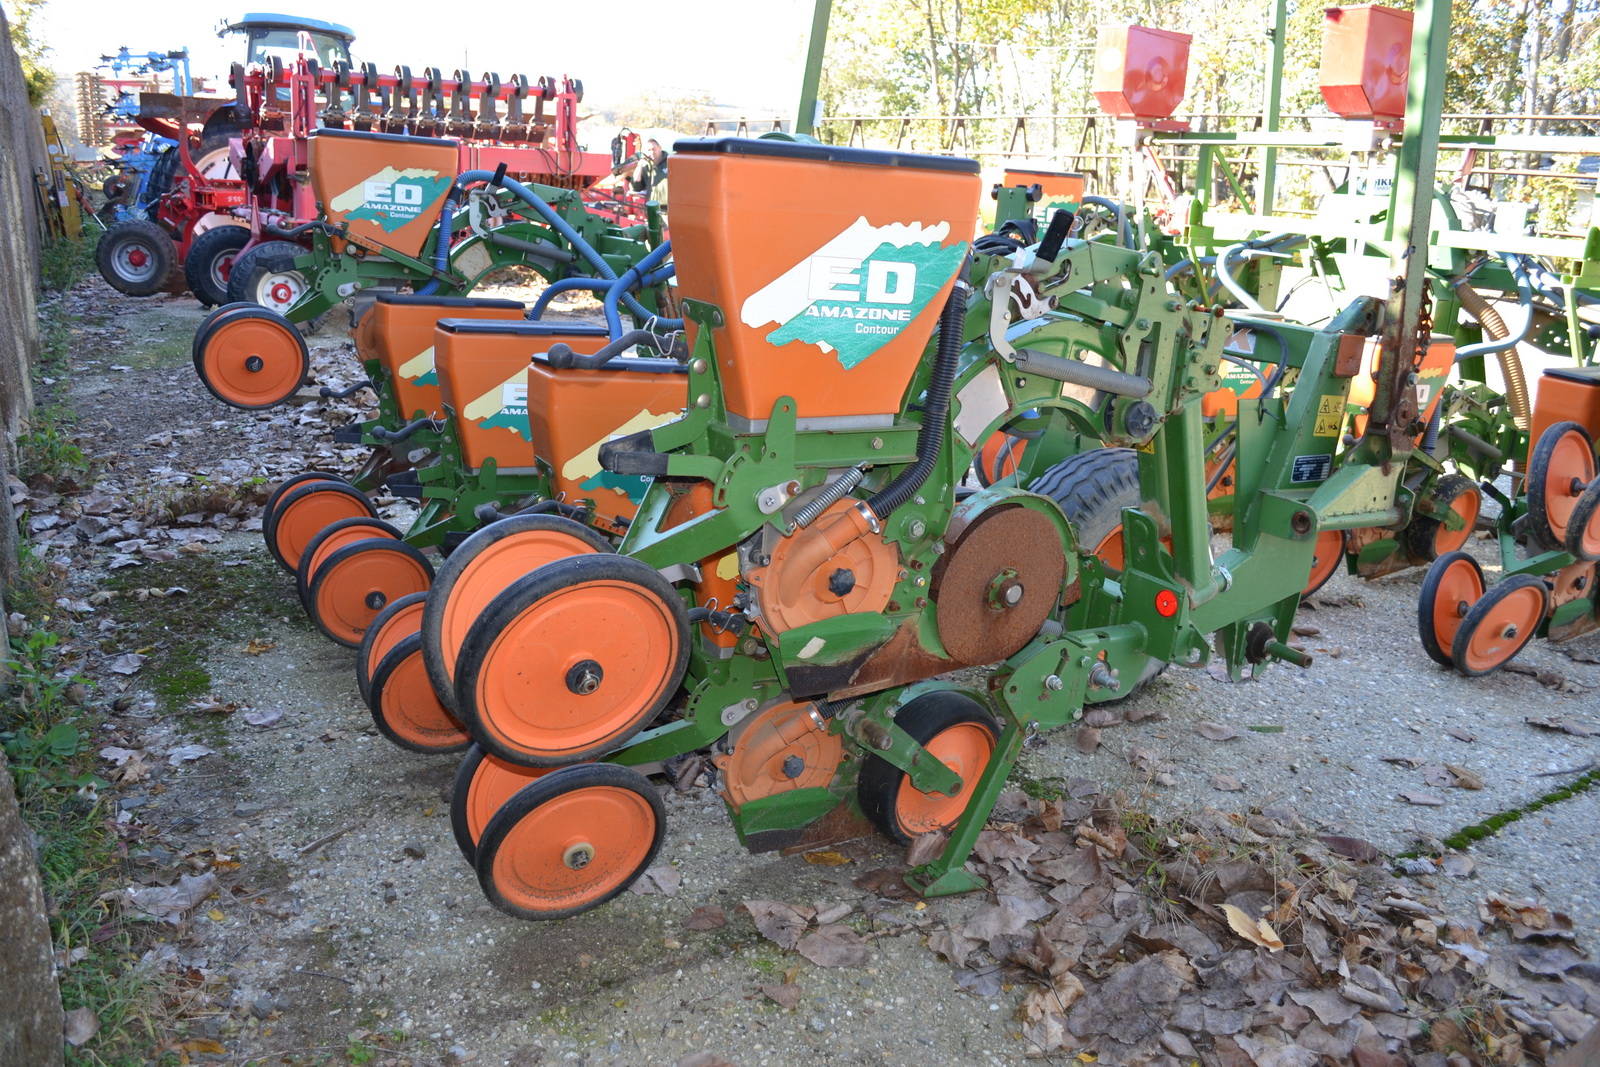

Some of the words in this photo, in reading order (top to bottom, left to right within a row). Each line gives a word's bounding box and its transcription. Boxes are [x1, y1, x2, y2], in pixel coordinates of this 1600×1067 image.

[363, 180, 423, 206] ED
[363, 202, 422, 213] AMAZONE
[389, 211, 416, 219] Contour
[807, 256, 917, 304] ED
[804, 305, 912, 321] AMAZONE
[854, 322, 900, 335] Contour
[501, 382, 528, 407] E
[1415, 384, 1431, 403] D
